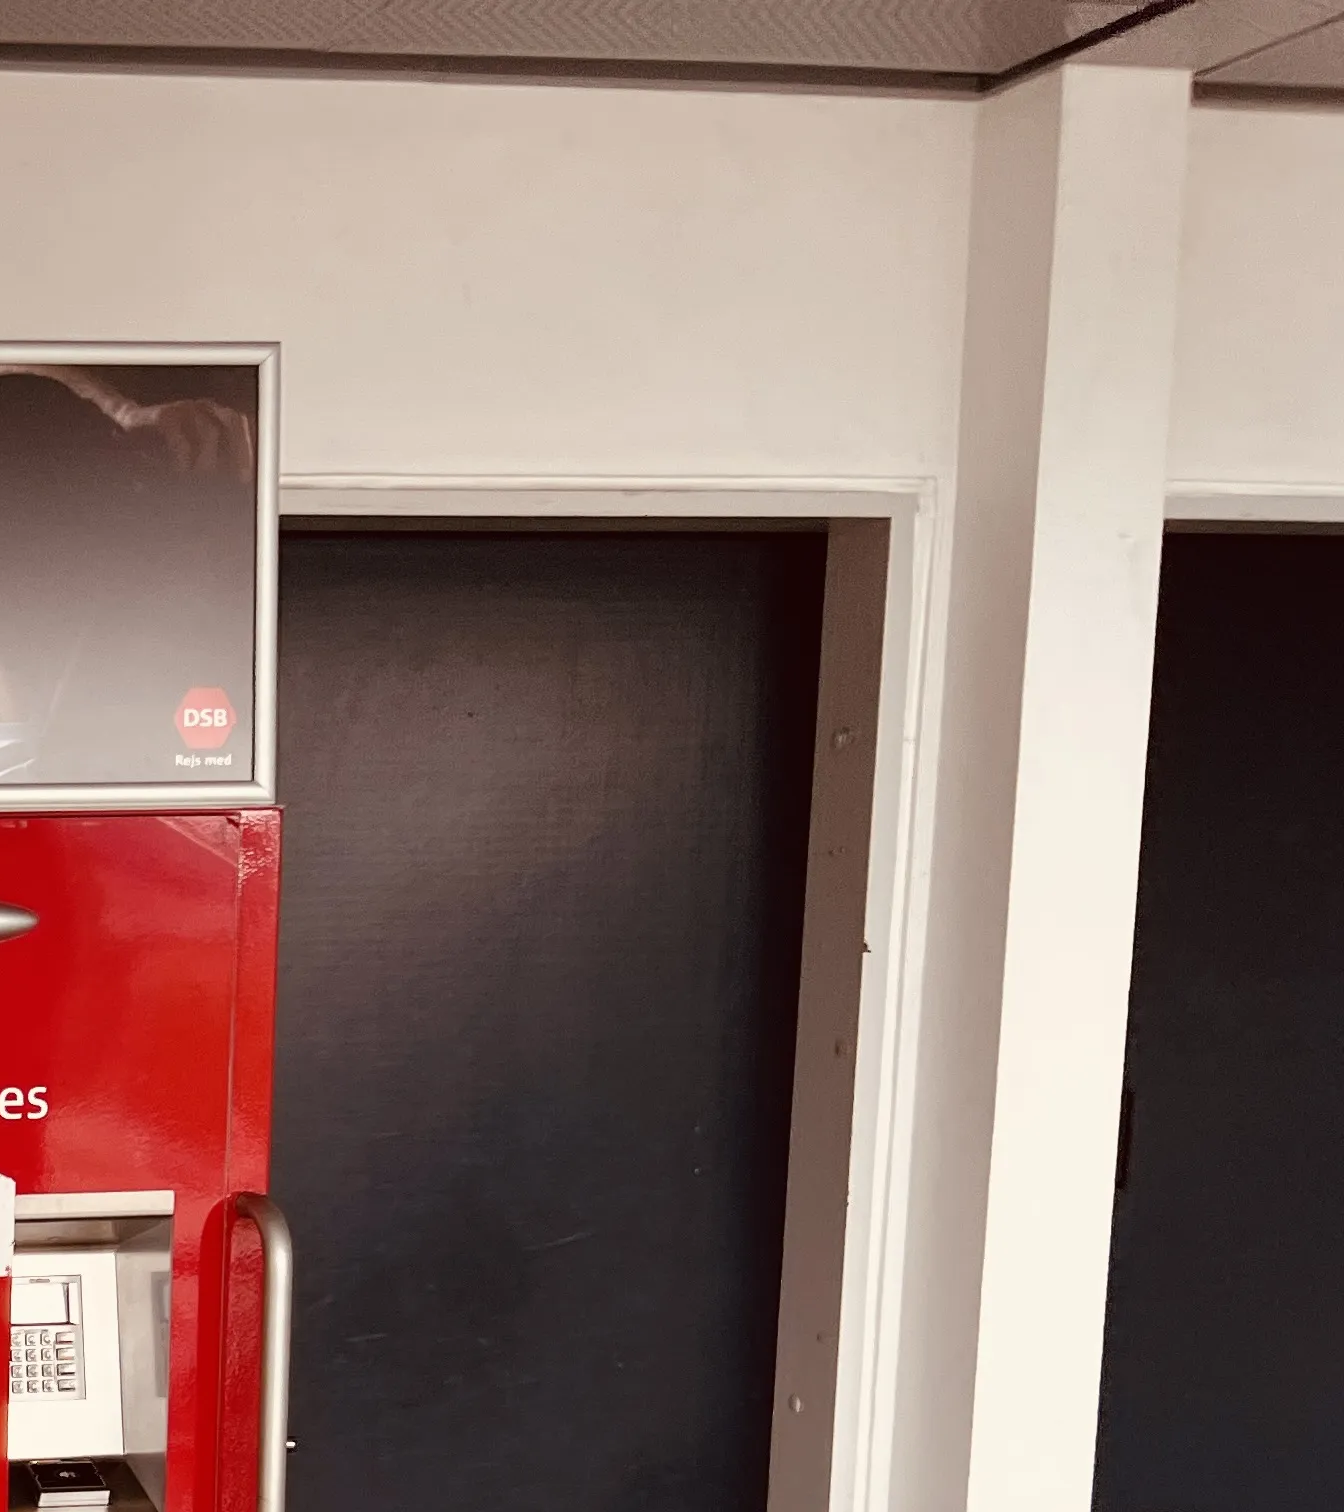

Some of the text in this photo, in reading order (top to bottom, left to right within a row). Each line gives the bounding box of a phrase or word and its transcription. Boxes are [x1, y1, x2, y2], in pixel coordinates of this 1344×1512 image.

[183, 708, 228, 727] DSB
[175, 753, 232, 768] Rejs med
